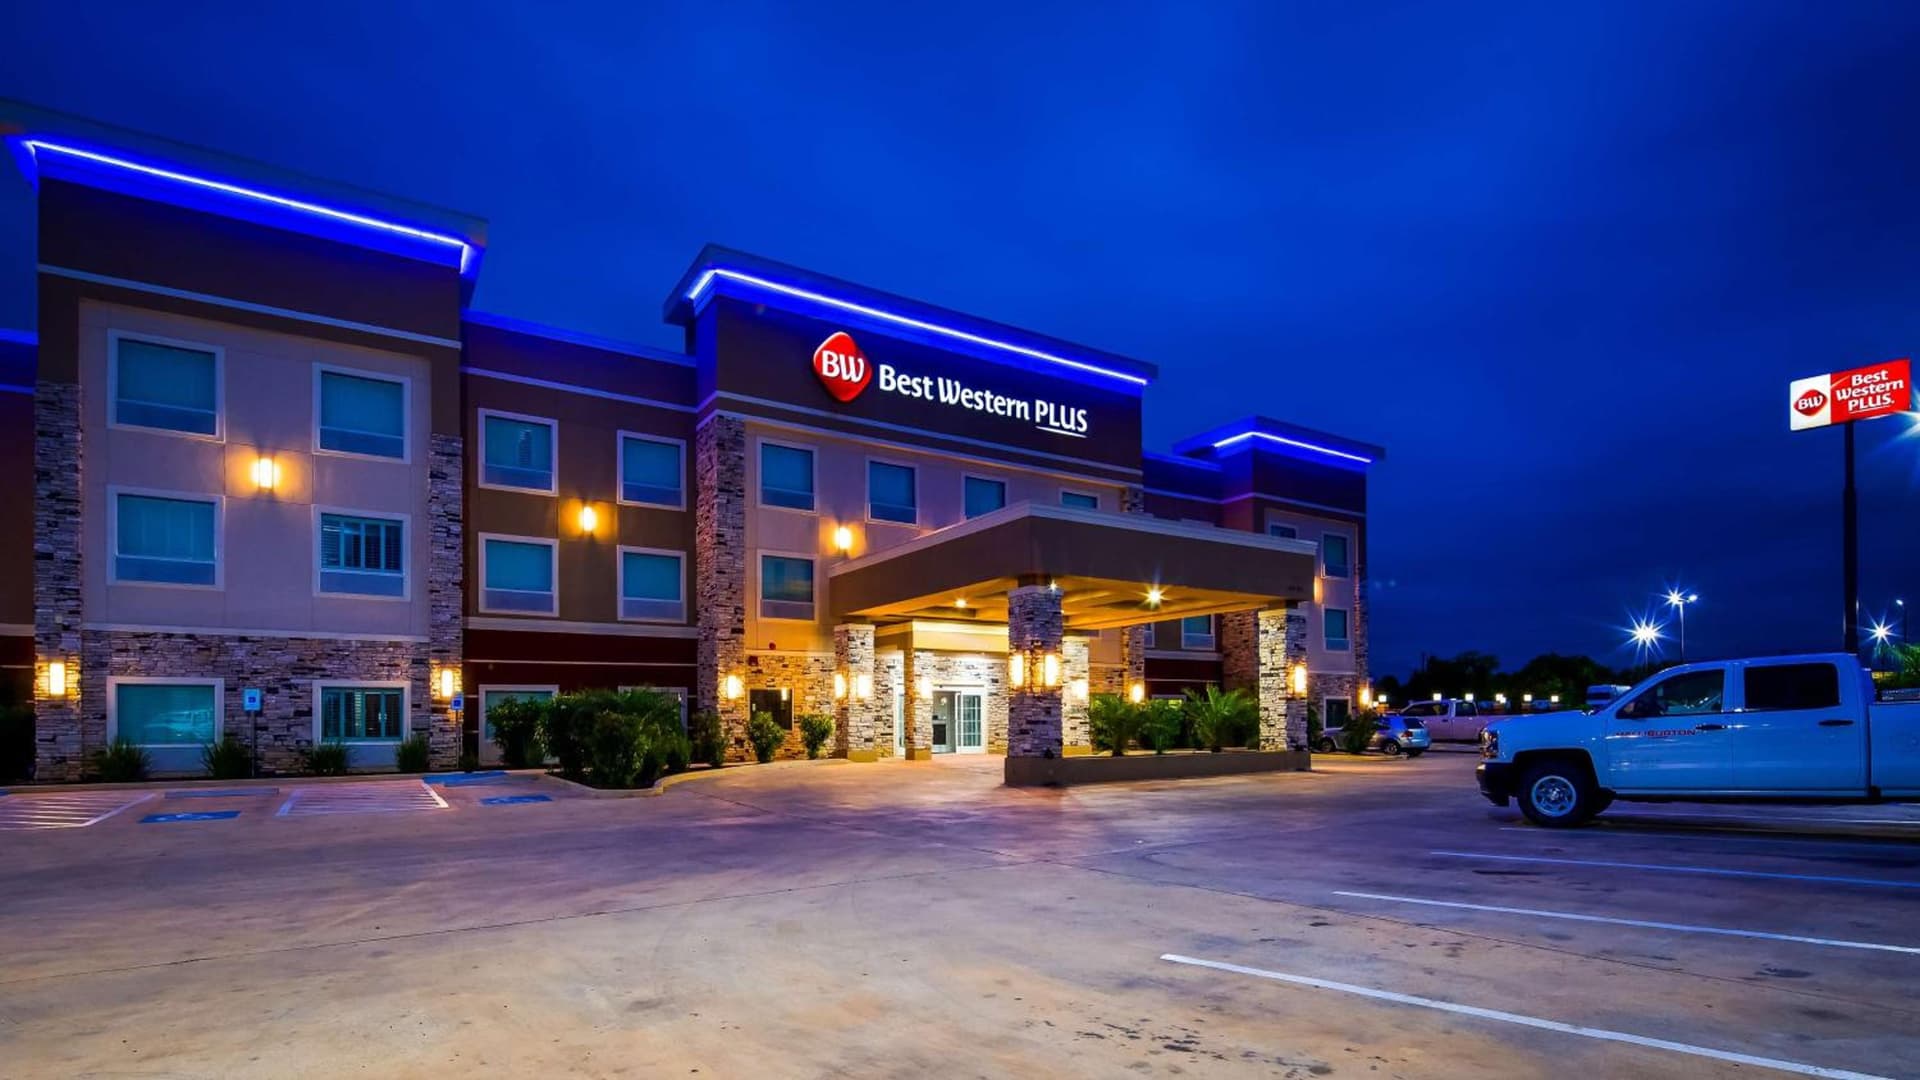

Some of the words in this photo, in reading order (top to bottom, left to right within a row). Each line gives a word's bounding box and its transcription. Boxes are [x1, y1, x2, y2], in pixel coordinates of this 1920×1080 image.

[821, 350, 864, 383] BW
[1851, 369, 1889, 387] Best
[879, 364, 934, 400] Best
[937, 376, 1031, 420] Western
[1035, 399, 1088, 433] PLUS
[1835, 379, 1904, 401] Western
[1798, 395, 1823, 410] BW
